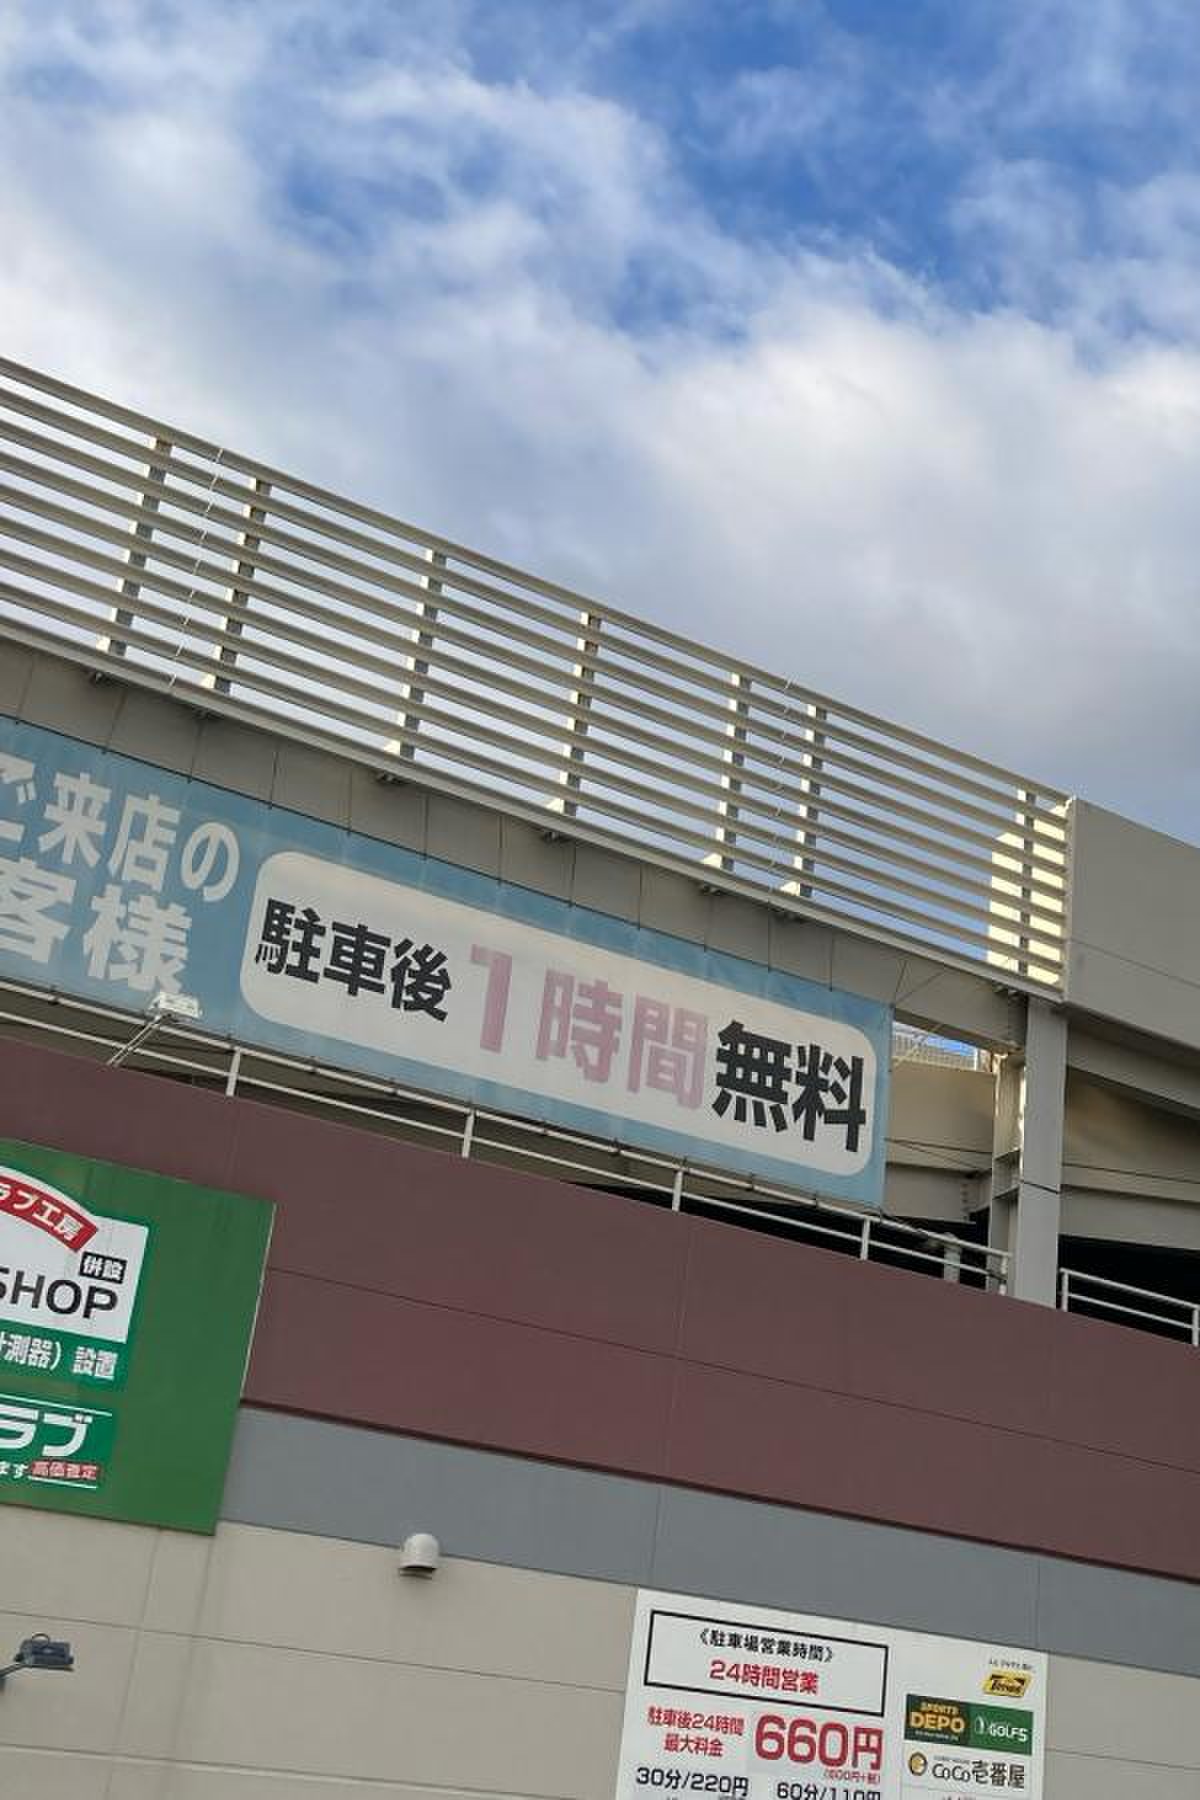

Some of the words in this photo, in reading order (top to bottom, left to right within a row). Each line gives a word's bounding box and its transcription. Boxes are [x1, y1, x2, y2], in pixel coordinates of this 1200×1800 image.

[0, 856, 193, 995] 客様
[709, 1659, 819, 1695] 24時間営業
[648, 1706, 744, 1737] 駐車後24時間
[910, 1711, 966, 1734] DEPO
[664, 1732, 724, 1757] 最大料金
[755, 1714, 884, 1770] 660円
[636, 1766, 749, 1797] 30分/220円
[931, 1760, 1025, 1789] CoCo壱番屋
